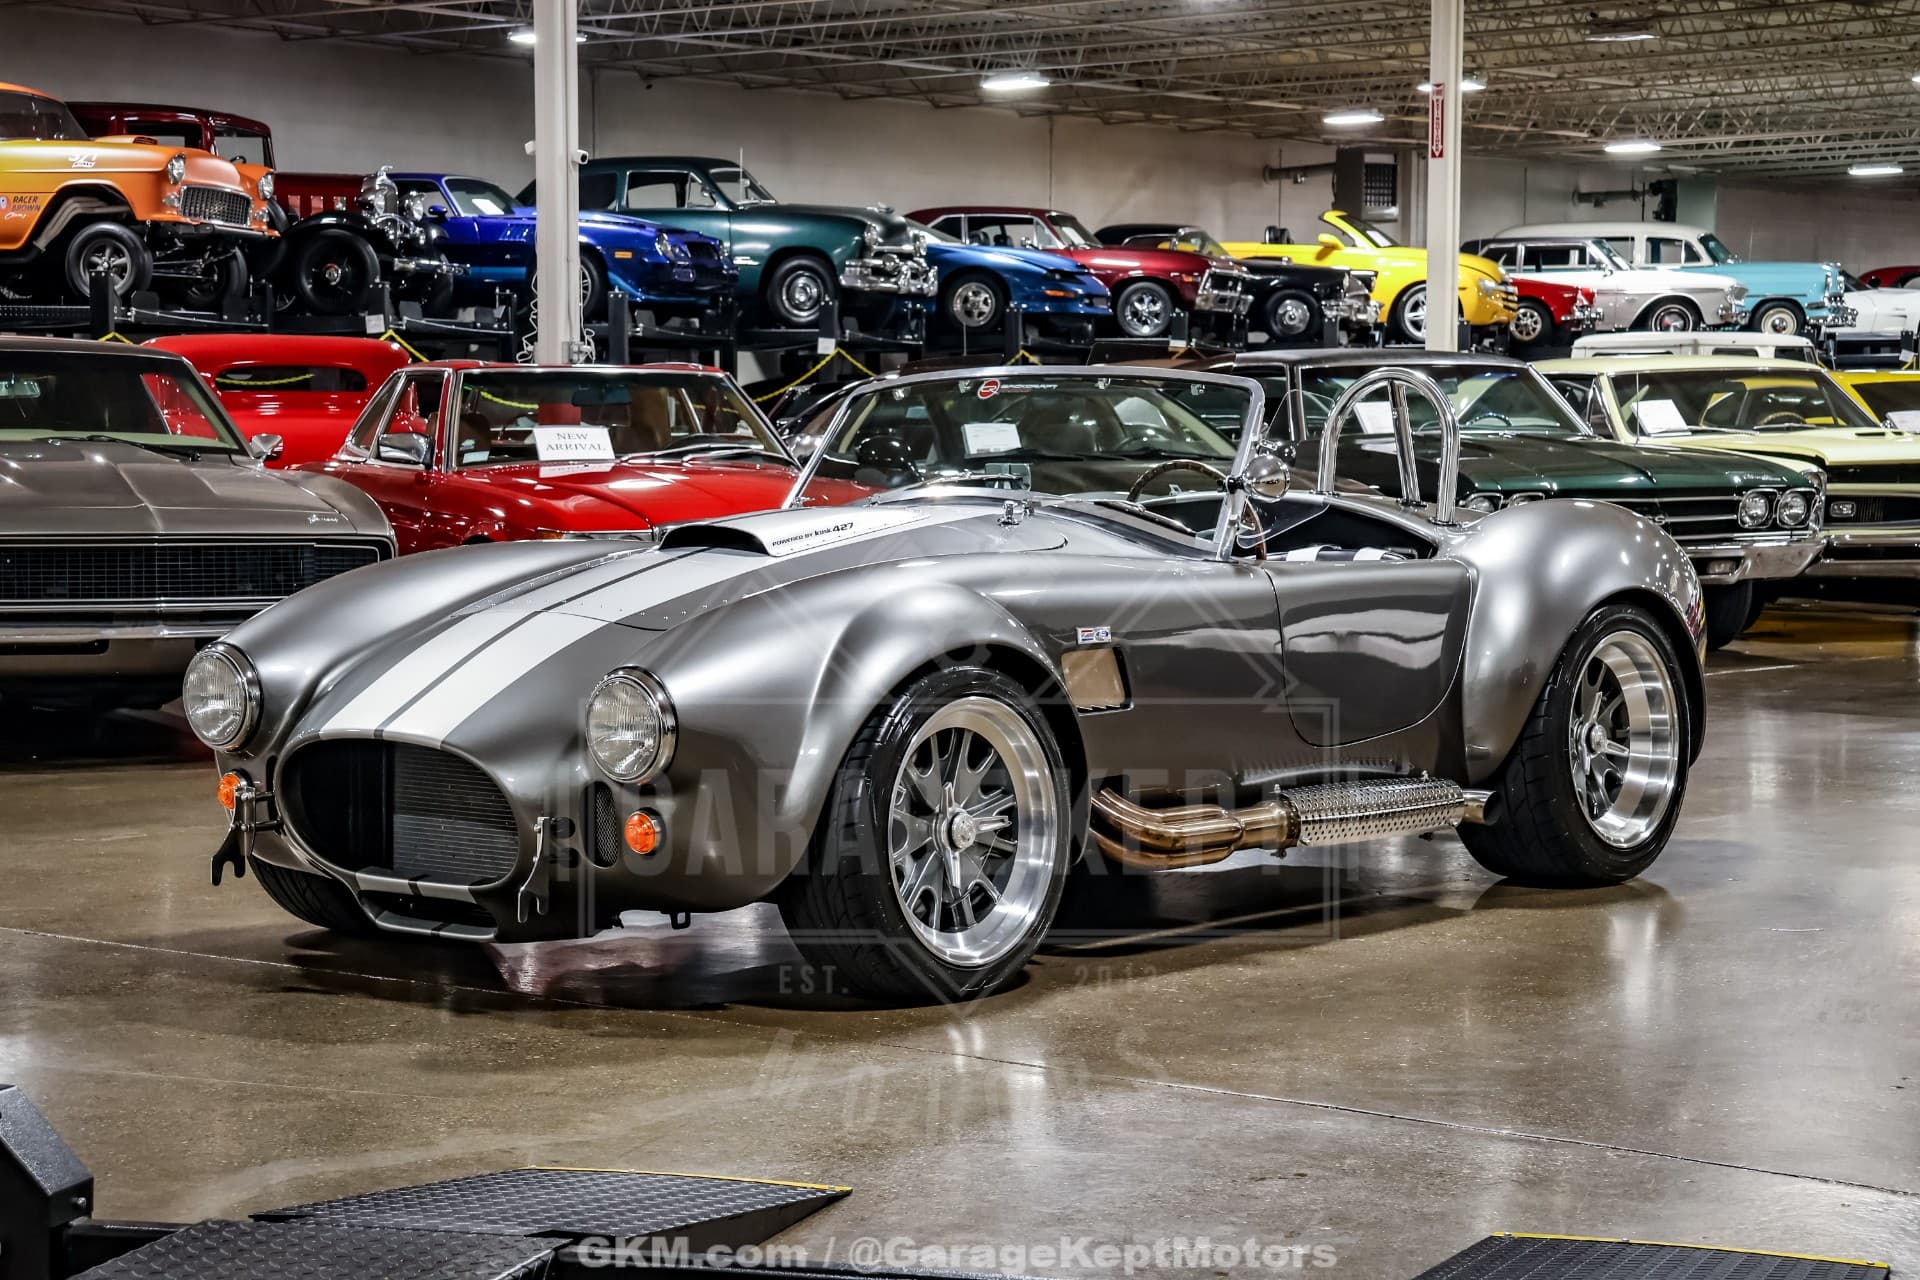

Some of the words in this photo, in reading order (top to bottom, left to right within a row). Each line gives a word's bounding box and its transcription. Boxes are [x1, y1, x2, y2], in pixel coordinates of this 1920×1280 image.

[13, 195, 38, 204] RACER
[546, 443, 606, 451] ARRIVAL
[772, 534, 804, 547] POWERED
[832, 522, 854, 532] 427
